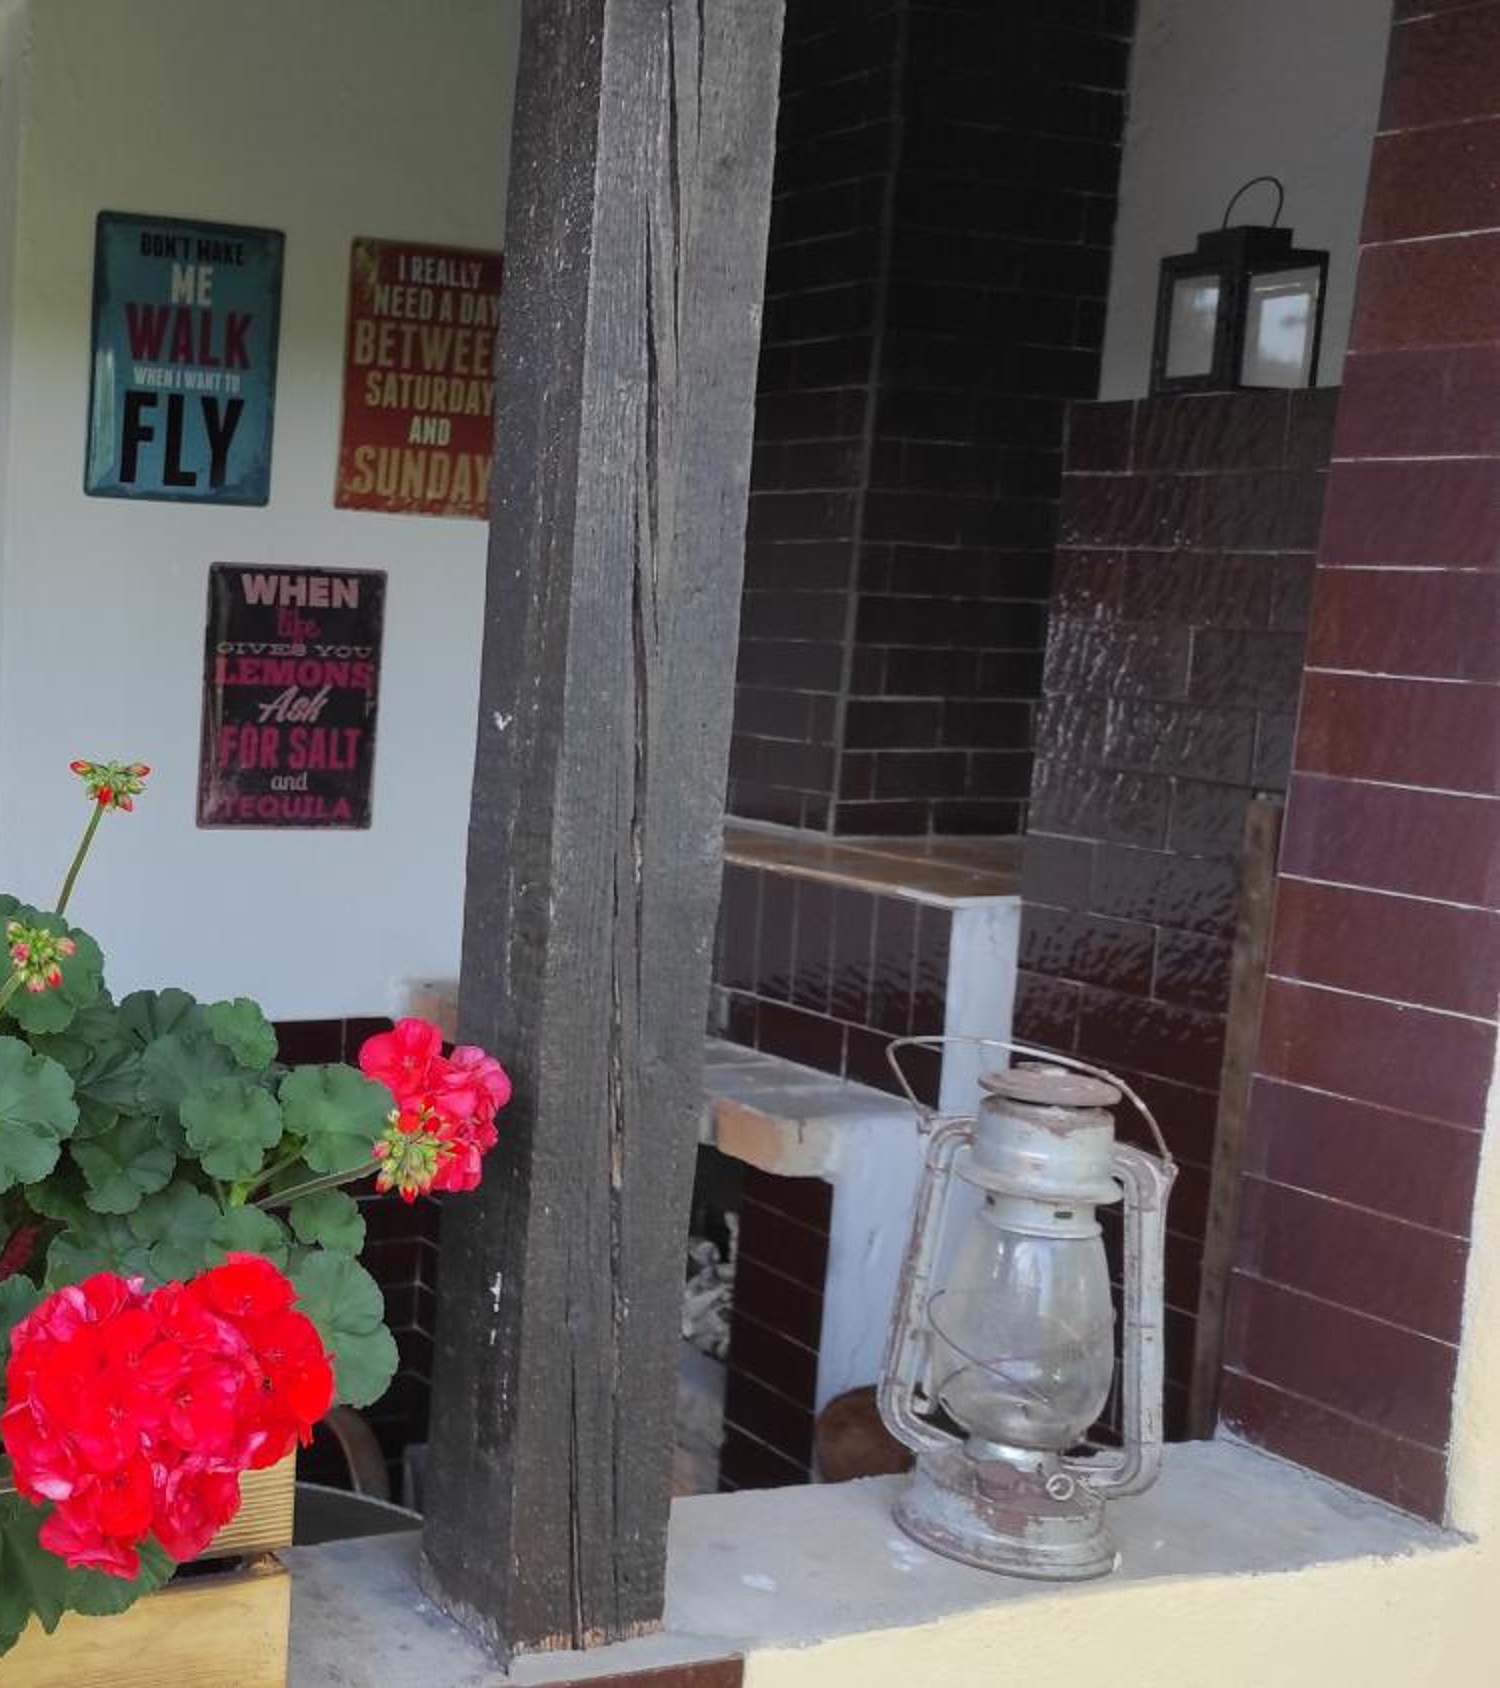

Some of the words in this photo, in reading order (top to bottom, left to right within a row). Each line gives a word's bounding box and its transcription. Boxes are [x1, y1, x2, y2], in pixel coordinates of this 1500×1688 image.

[140, 233, 191, 260] DON'T
[196, 239, 245, 267] MAKE
[170, 262, 214, 306] ME
[398, 254, 405, 283] I
[411, 256, 484, 289] REALLY
[373, 284, 433, 320] NEED
[439, 290, 453, 323] A
[125, 302, 254, 370] WALK
[354, 321, 497, 376] BETWEE
[132, 366, 174, 388] WHEN
[182, 370, 222, 391] WANT
[223, 372, 242, 393] TO
[364, 370, 497, 417] SATURDAY
[119, 389, 245, 490] FLY
[408, 415, 452, 447] AND
[352, 445, 493, 503] SUNDAY
[241, 573, 359, 609] WHEN
[216, 641, 307, 658] GIVES
[315, 643, 373, 659] YOU
[214, 655, 375, 689] LEMONS
[257, 683, 333, 724] Ask
[218, 724, 281, 770] FOR
[287, 726, 363, 770] SALT
[270, 771, 309, 792] and
[220, 794, 353, 820] TEQUILA
